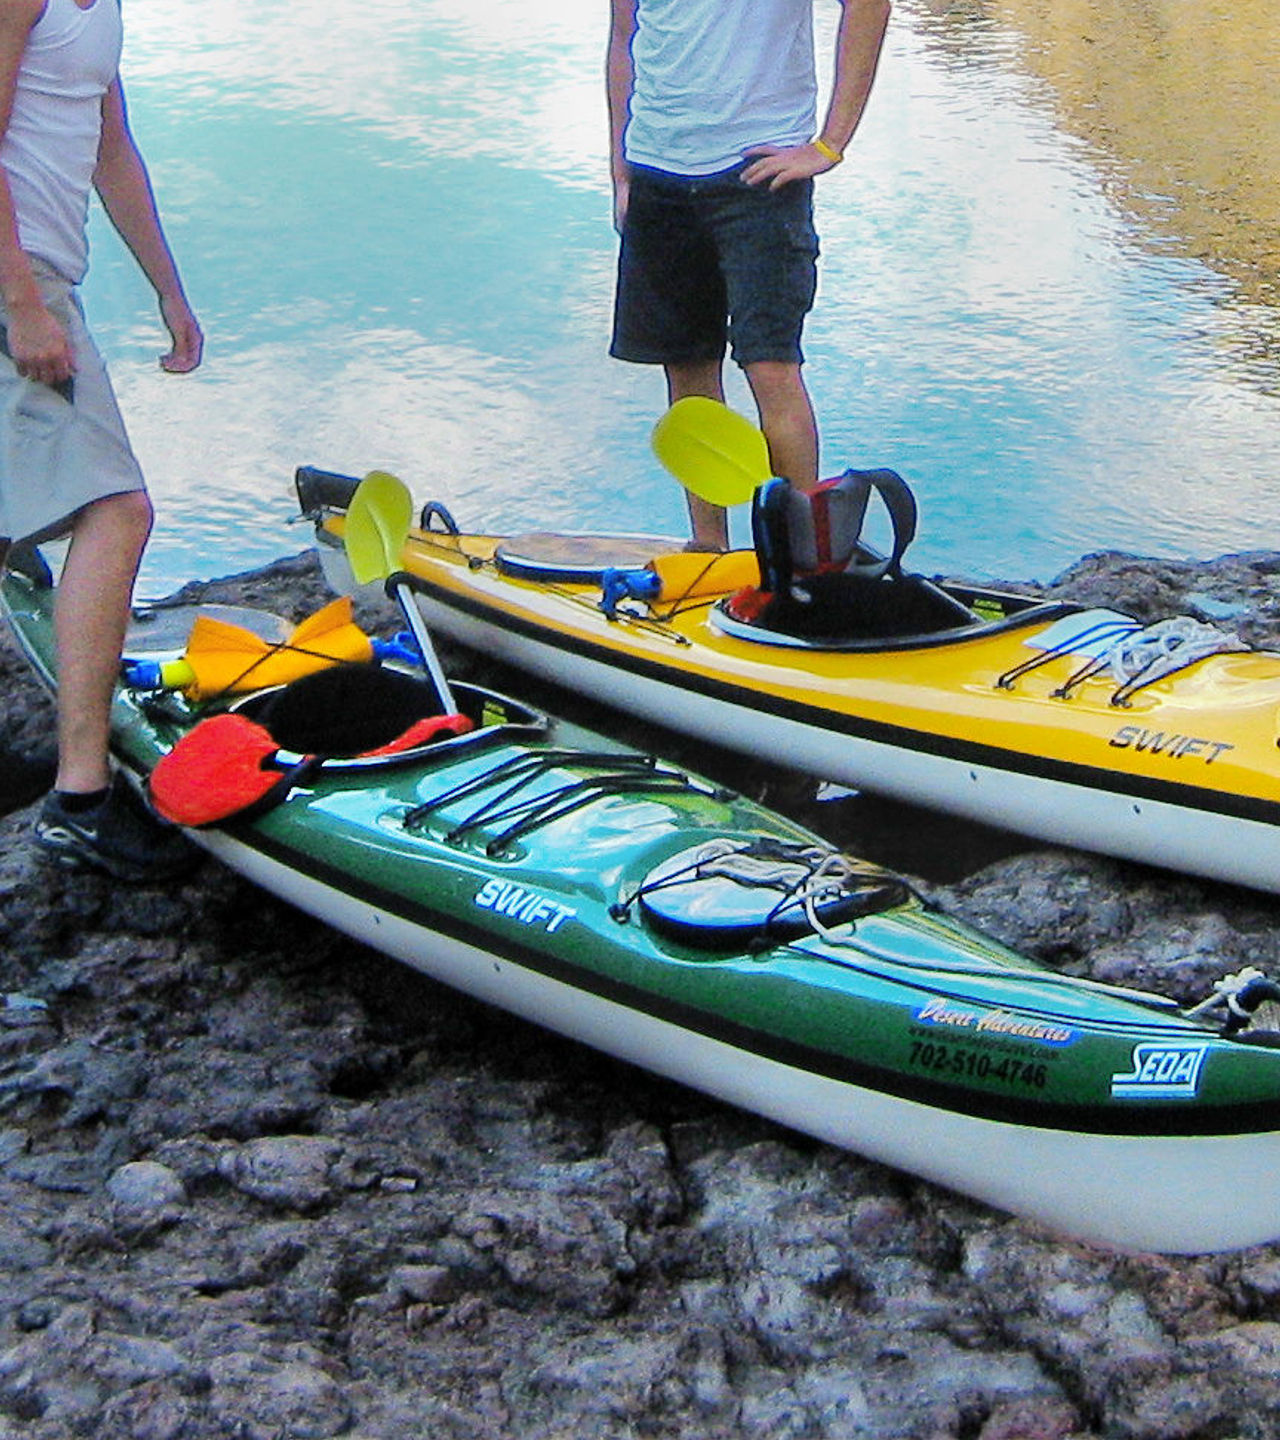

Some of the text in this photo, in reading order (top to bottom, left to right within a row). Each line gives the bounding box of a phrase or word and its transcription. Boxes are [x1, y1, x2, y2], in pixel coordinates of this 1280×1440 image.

[1108, 726, 1235, 765] SWIFT
[475, 879, 577, 933] SWIFT
[909, 1041, 1048, 1088] 702-510-4746
[1111, 1042, 1209, 1093] SEDA
